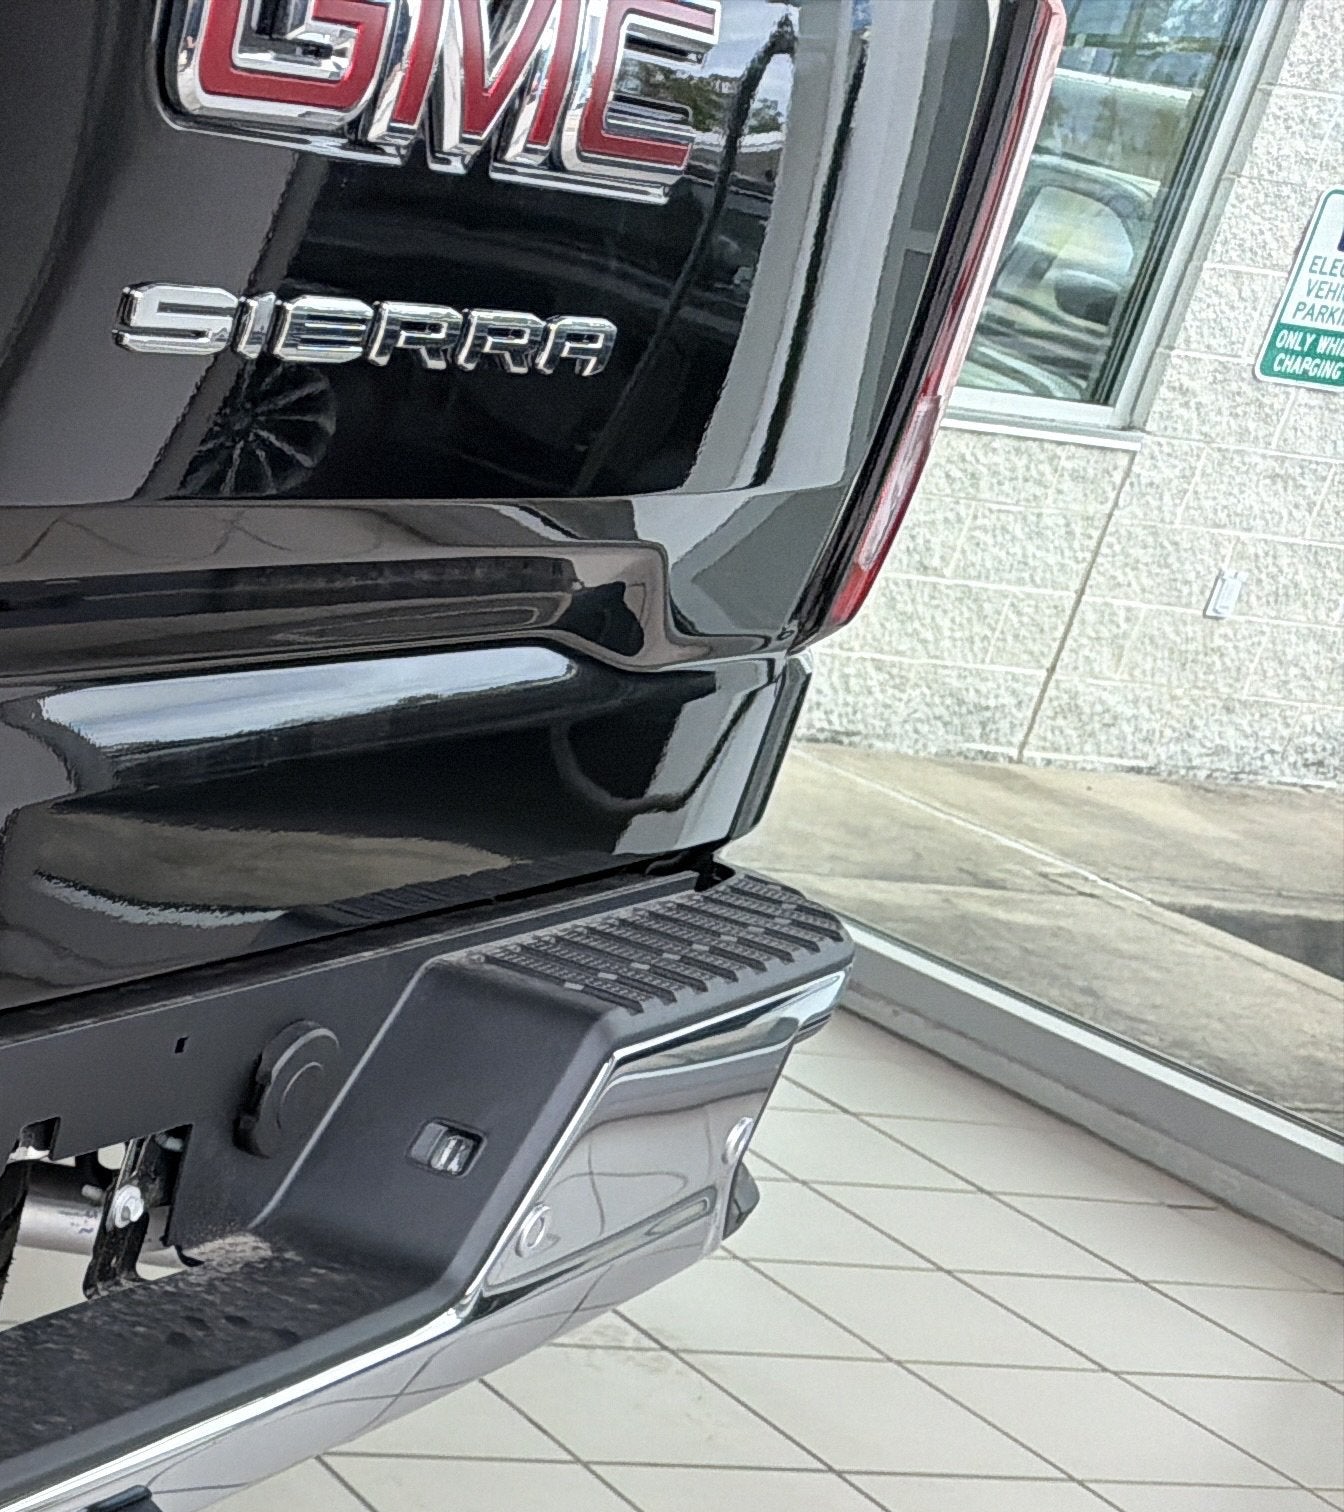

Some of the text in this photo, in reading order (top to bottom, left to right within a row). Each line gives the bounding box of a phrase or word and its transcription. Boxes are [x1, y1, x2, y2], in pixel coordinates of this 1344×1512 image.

[157, 0, 719, 205] GMC
[1306, 278, 1344, 302] VEHI
[1292, 301, 1344, 326] PARKI
[113, 281, 617, 377] SIERRA
[1275, 329, 1316, 352] ONLY
[1273, 353, 1344, 380] CHARGING
